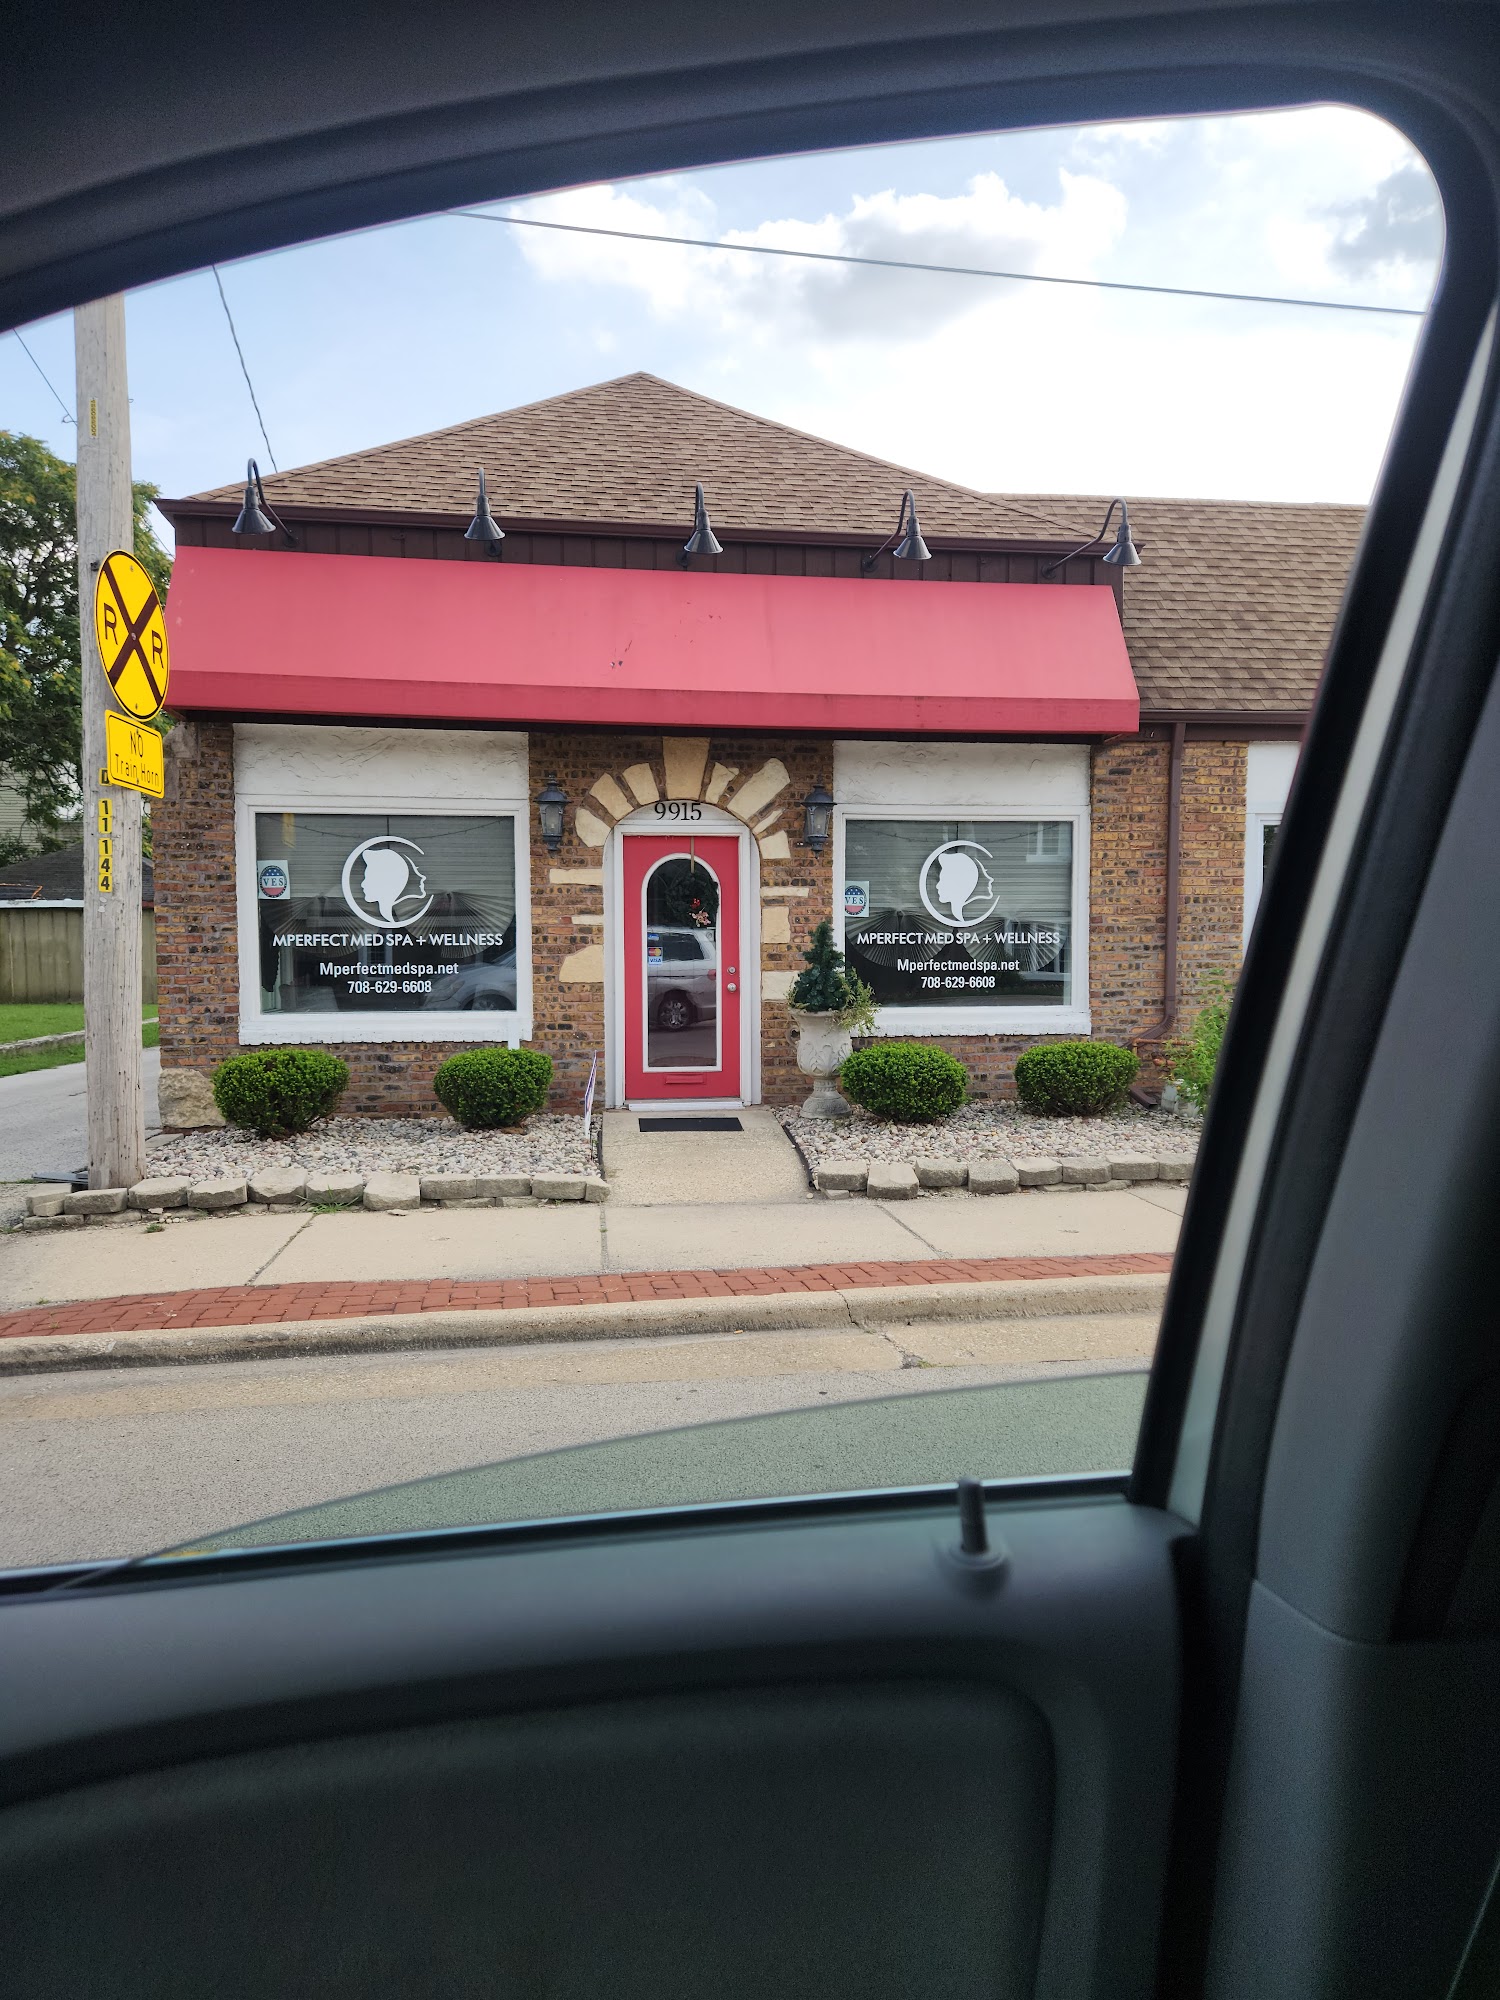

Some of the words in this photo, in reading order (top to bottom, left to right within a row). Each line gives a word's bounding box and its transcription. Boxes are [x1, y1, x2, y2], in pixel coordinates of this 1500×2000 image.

[104, 603, 118, 645] R
[152, 630, 164, 669] R
[130, 731, 143, 758] NO
[115, 753, 137, 778] Train
[140, 762, 160, 787] Horn
[654, 802, 702, 821] 9915
[263, 877, 284, 887] VES
[272, 933, 349, 947] MPERFECT
[350, 934, 384, 947] MED
[385, 933, 414, 946] SPA
[429, 933, 503, 946] WELLNESS
[856, 932, 923, 945] MPERFECT
[924, 933, 954, 945] MED
[955, 932, 981, 945] SPA
[994, 932, 1061, 944] WELLNESS
[319, 962, 459, 978] Mperfectmedspa.net
[897, 959, 1020, 973] Mperfectmedspa.net
[347, 981, 432, 994] 708-629-6608
[921, 976, 996, 988] 708-629-6608
